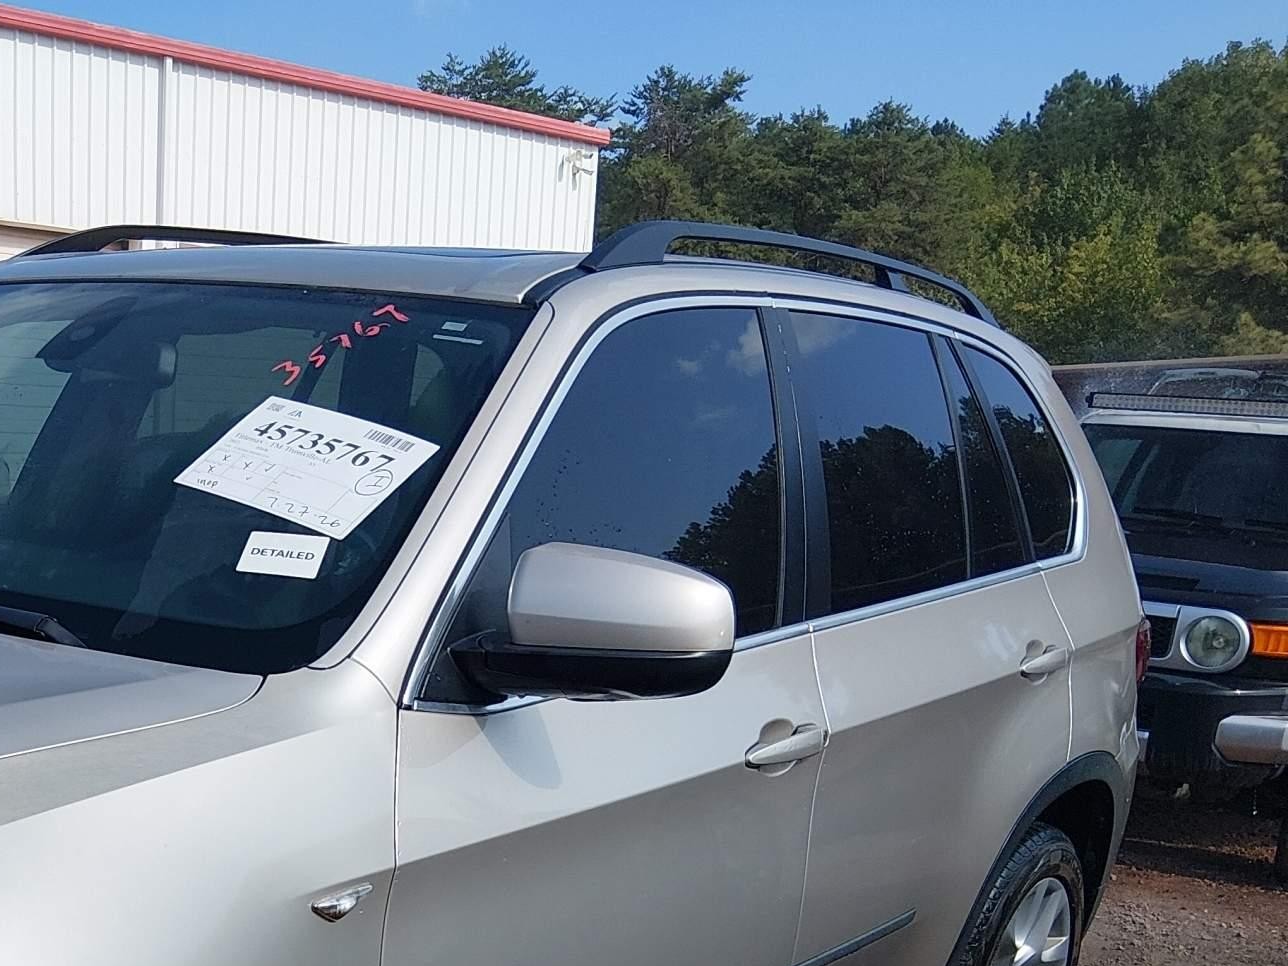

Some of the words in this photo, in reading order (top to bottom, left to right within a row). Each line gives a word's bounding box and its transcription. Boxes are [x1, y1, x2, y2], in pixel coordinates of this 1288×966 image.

[271, 304, 410, 386] 35767
[253, 421, 396, 473] 45735767
[250, 547, 316, 561] DETAILED
